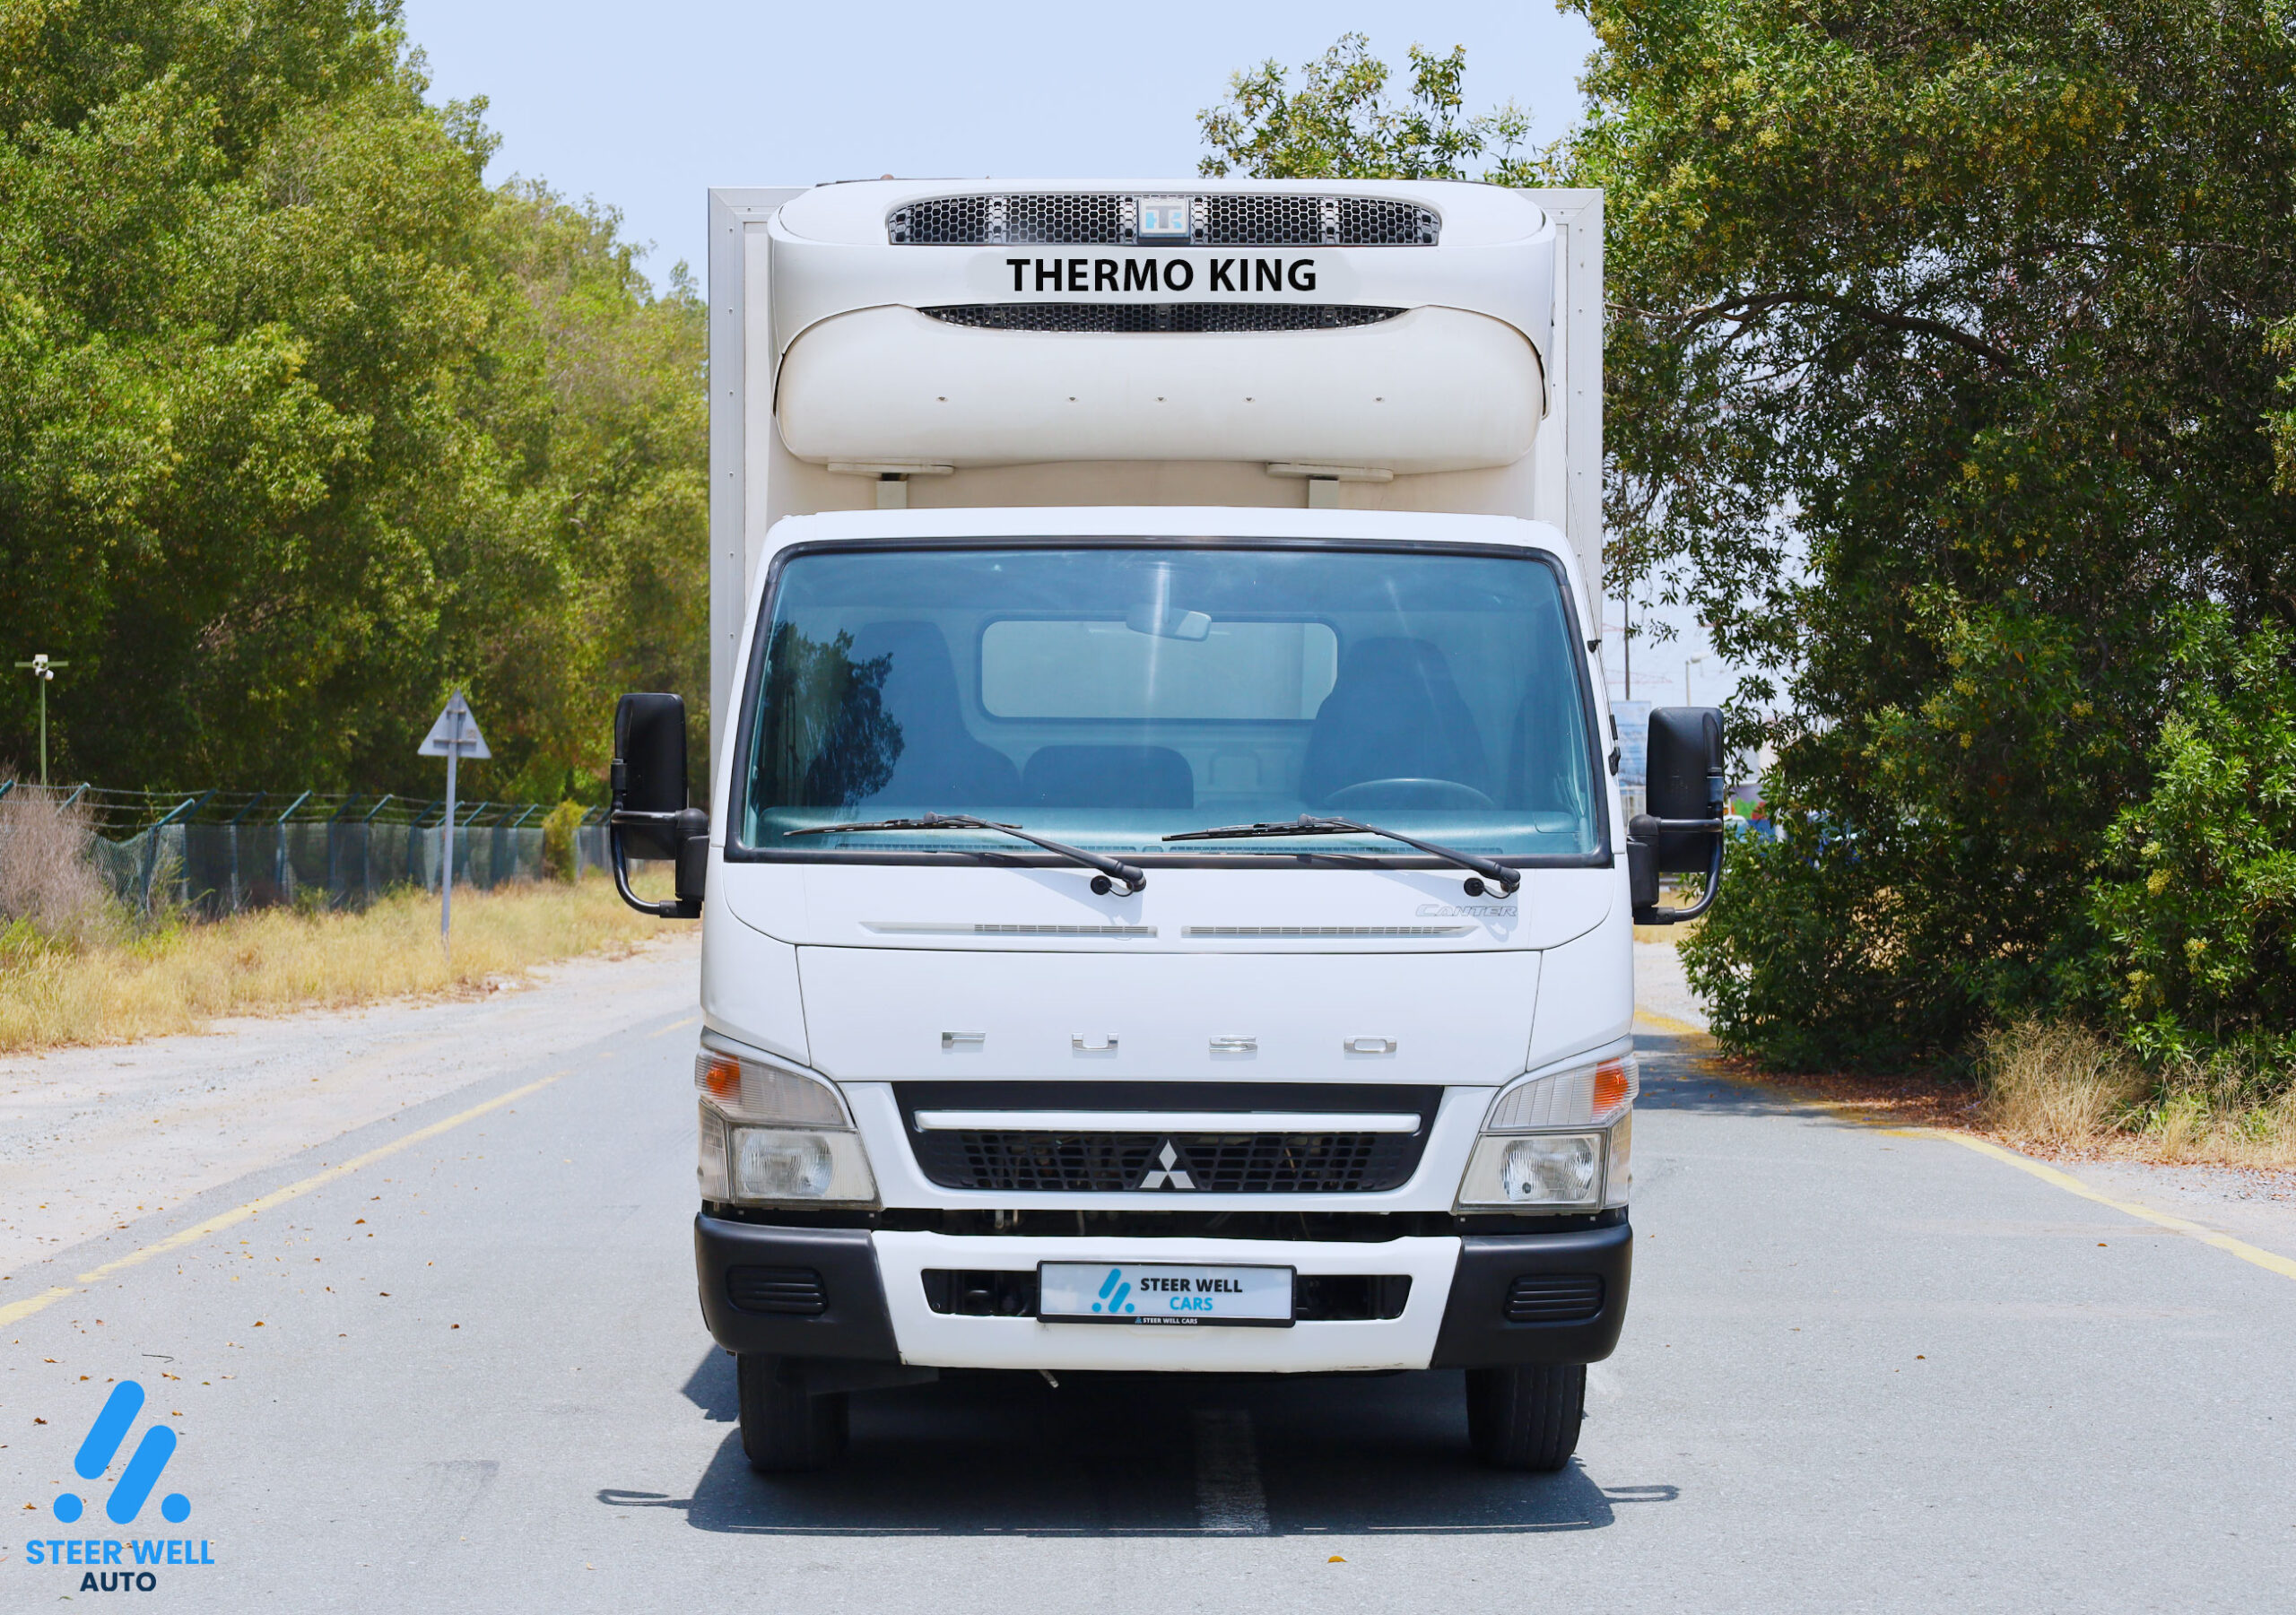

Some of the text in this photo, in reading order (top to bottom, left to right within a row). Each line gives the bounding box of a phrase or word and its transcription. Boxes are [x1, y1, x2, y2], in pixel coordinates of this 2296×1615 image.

[1005, 258, 1317, 292] THERMO KING
[1415, 904, 1518, 916] CANTER
[941, 1030, 1397, 1055] FUSO
[1140, 1277, 1243, 1293] STEER WELL
[1170, 1296, 1213, 1312] CARS
